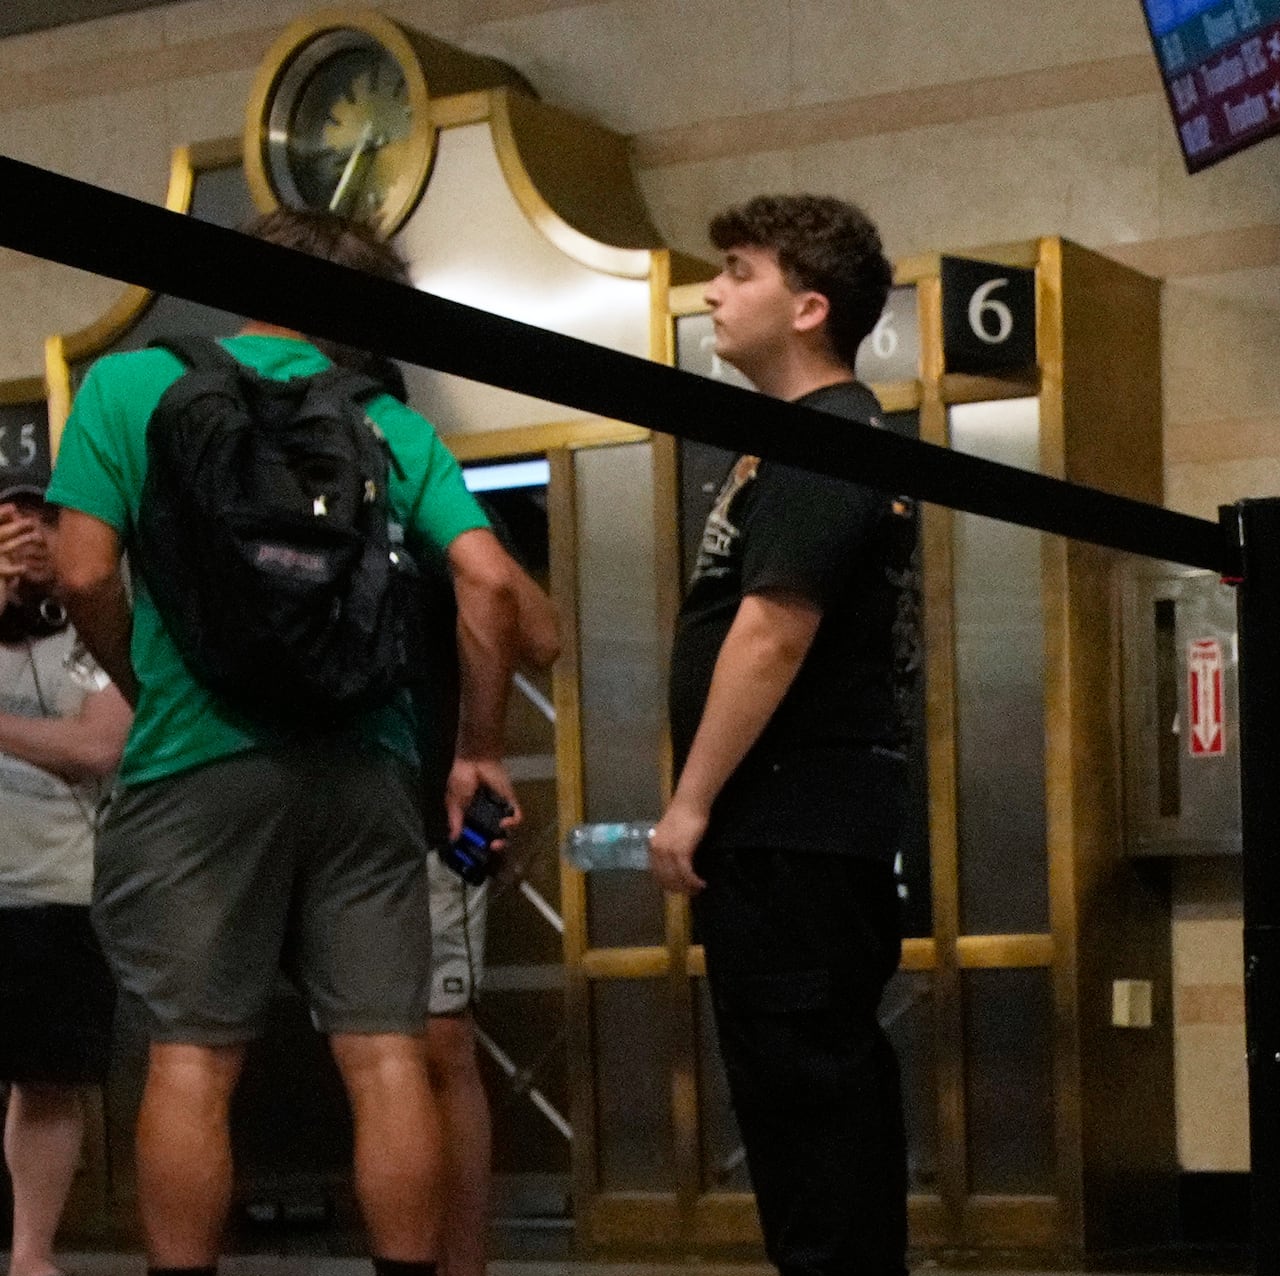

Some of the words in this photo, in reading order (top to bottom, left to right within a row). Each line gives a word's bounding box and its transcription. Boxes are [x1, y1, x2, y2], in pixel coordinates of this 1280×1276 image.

[871, 311, 898, 360] 6
[967, 277, 1014, 345] 6
[20, 423, 37, 465] 5
